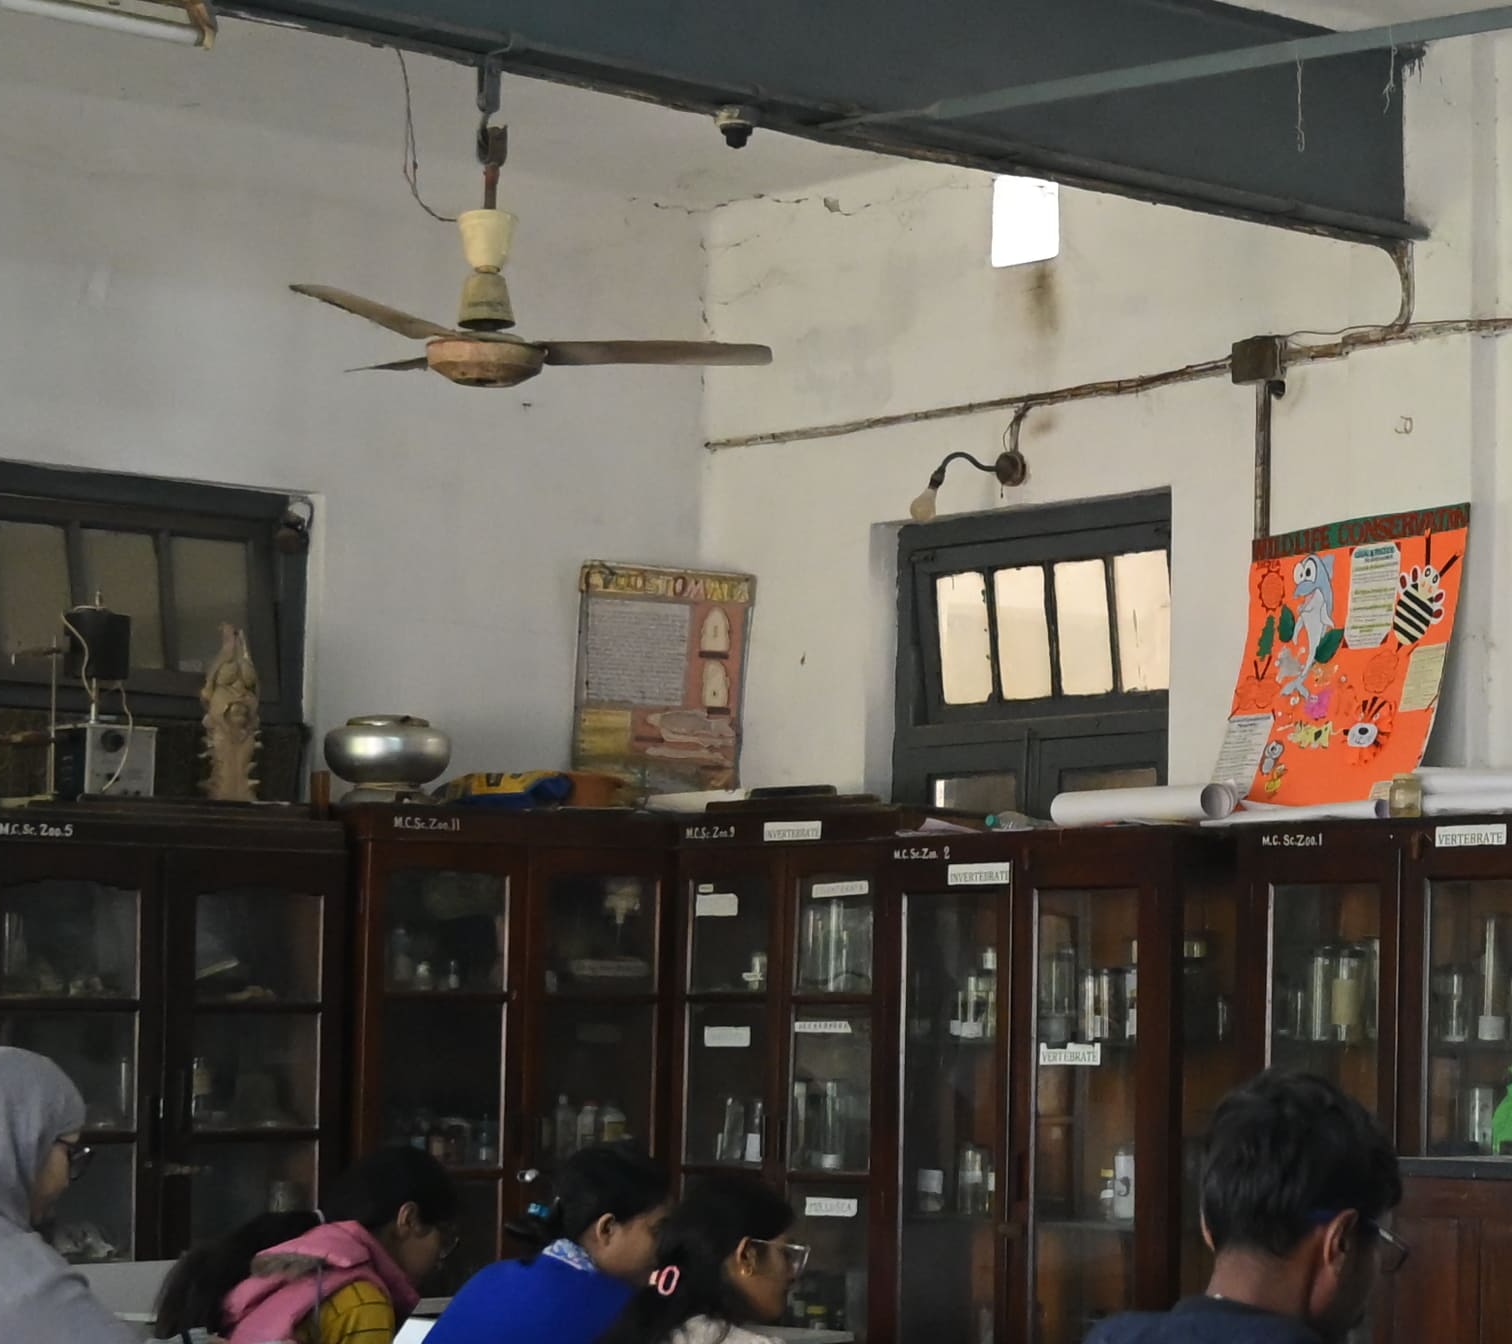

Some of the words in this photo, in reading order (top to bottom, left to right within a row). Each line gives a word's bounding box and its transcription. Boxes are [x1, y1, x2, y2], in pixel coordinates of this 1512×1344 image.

[1254, 526, 1330, 557] WILDLIFE
[1437, 831, 1504, 846] VERTEBRATE
[1041, 1051, 1097, 1062] VERTEBRATE
